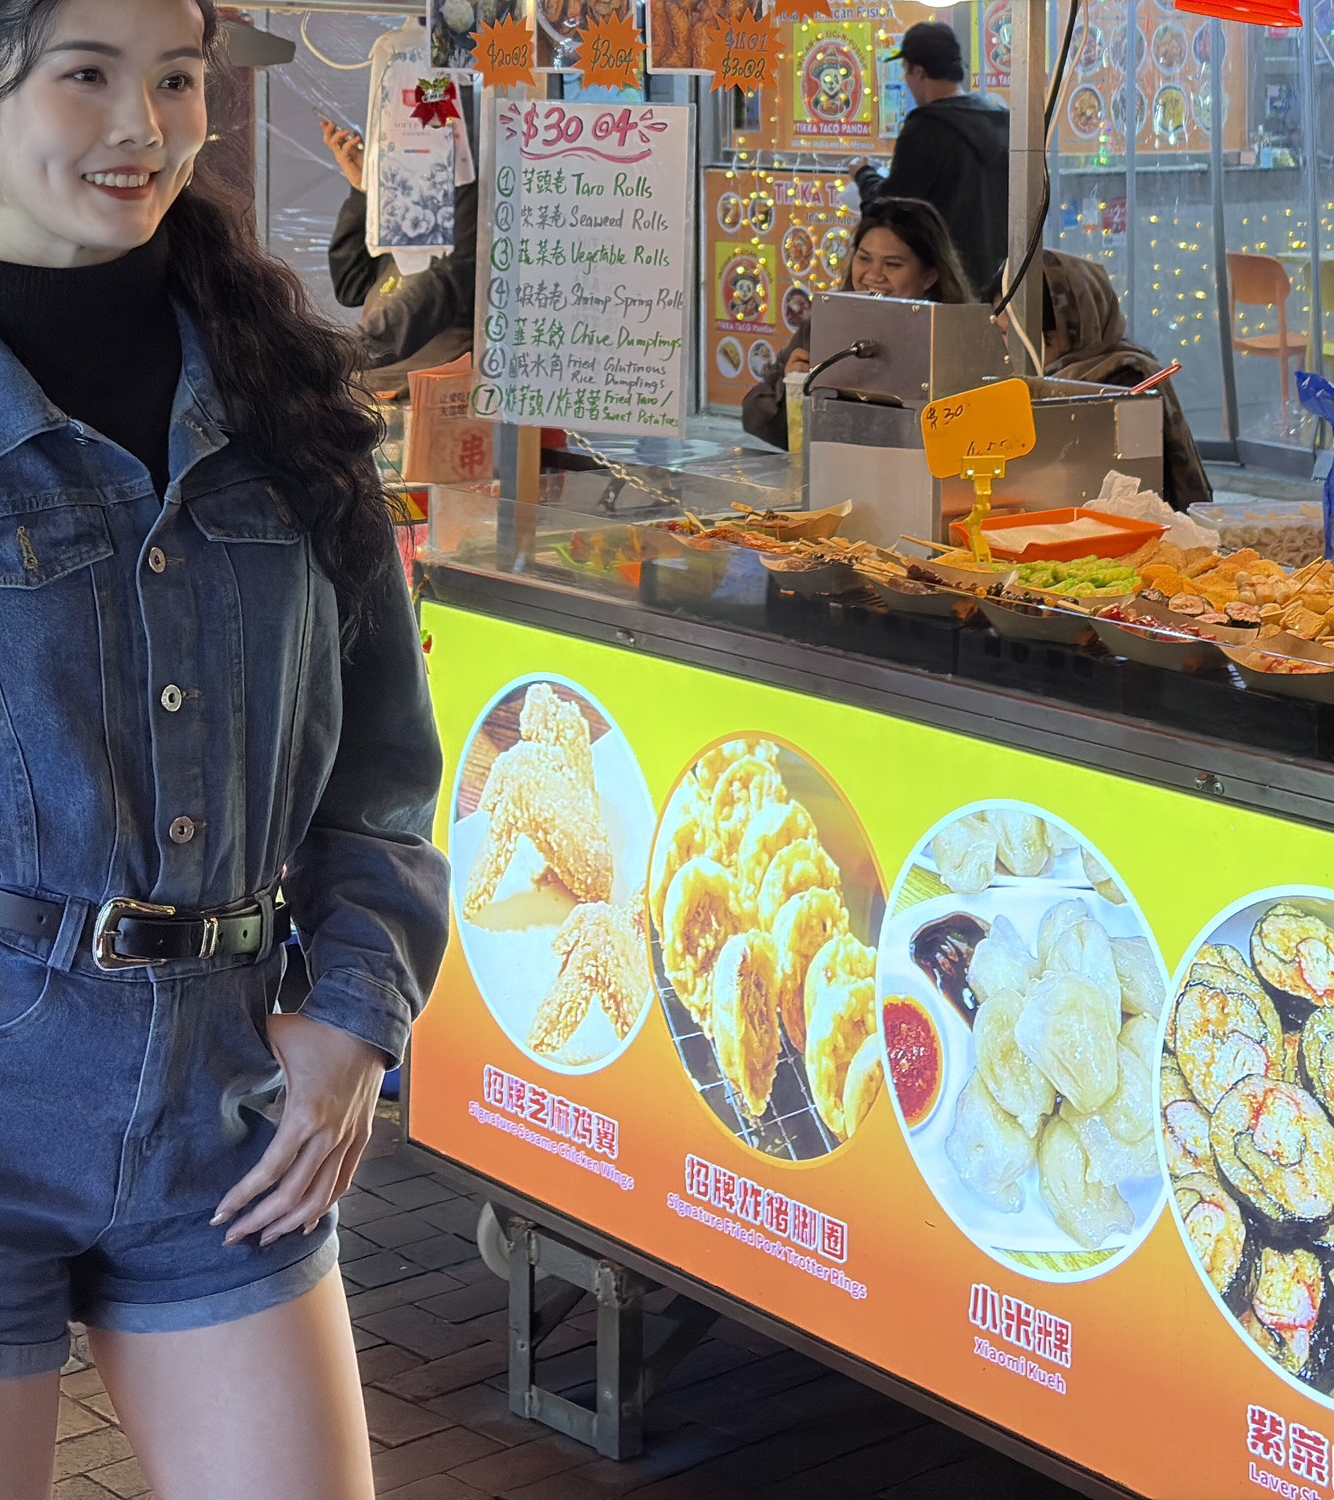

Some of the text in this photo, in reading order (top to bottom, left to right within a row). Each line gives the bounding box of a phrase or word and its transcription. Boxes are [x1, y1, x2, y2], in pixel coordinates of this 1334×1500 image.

[522, 102, 639, 148] $30 @4
[796, 122, 869, 135] TIKKA TACO PANDA
[571, 172, 604, 198] Taro
[613, 172, 653, 199] Rolls
[570, 205, 623, 229] Seaweed
[632, 207, 669, 231] Rolls
[571, 241, 628, 275] Vegetable
[634, 244, 670, 268] Rolls
[571, 282, 612, 314] Shrimp
[613, 284, 654, 323] Spring
[571, 321, 613, 348] Chive
[616, 328, 683, 361] Dumplings
[568, 354, 596, 374] Fried
[604, 356, 667, 376] Glutinous
[571, 371, 666, 394] Rice Dumplings
[602, 407, 679, 428] Sweet Potatoes
[603, 389, 632, 407] Fried
[635, 391, 658, 407] Taro
[483, 1064, 619, 1160] 招牌芝麻鸡翼
[468, 1101, 635, 1191] Signature Sesame Chicken Wings
[685, 1153, 848, 1264] 招牌炸猪脚圈
[667, 1191, 868, 1301] Signature Fried Pork Trotter Rings
[969, 1283, 1072, 1369] 小米粿
[973, 1335, 1067, 1395] Xiaomi Kueh
